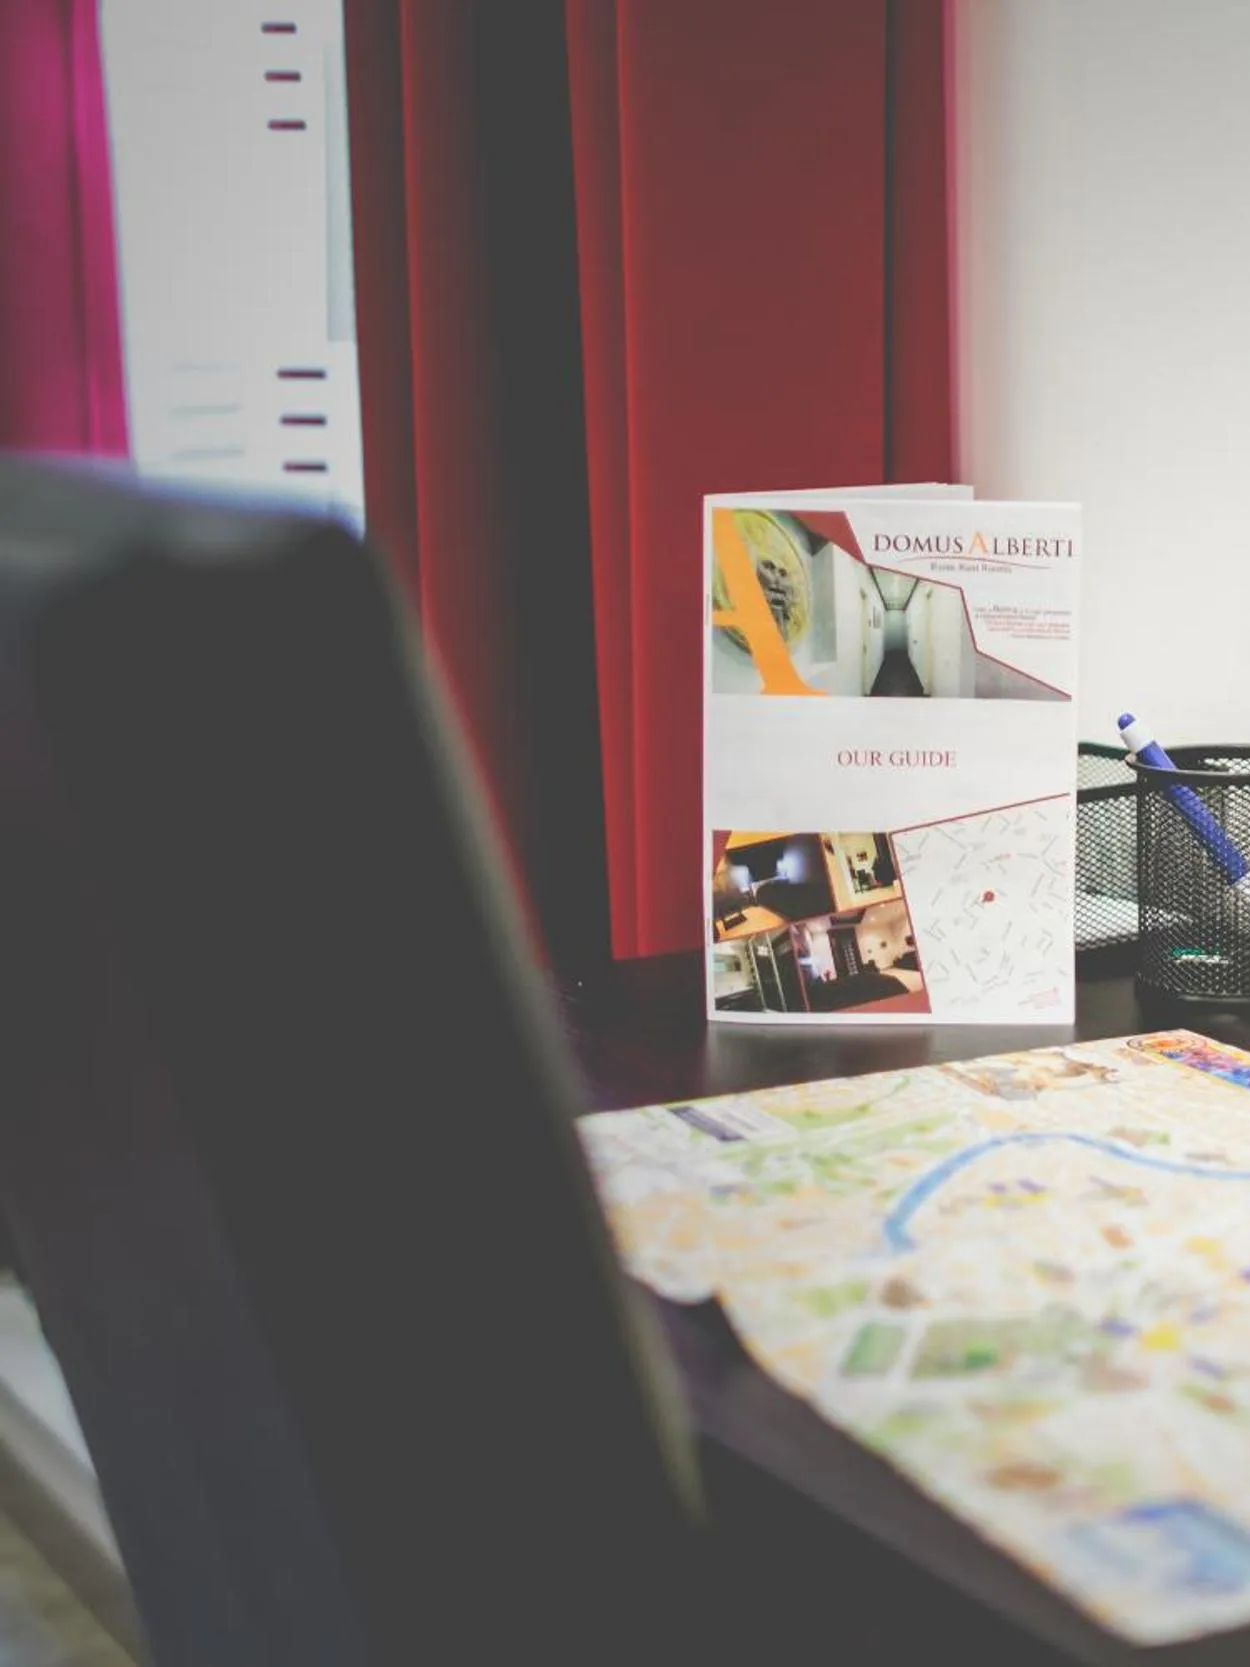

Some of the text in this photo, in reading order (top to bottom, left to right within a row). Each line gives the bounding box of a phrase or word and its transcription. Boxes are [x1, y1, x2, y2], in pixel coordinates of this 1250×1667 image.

[874, 531, 1073, 558] DOMUS ALBERTI
[837, 750, 957, 769] OUR GUIDE
